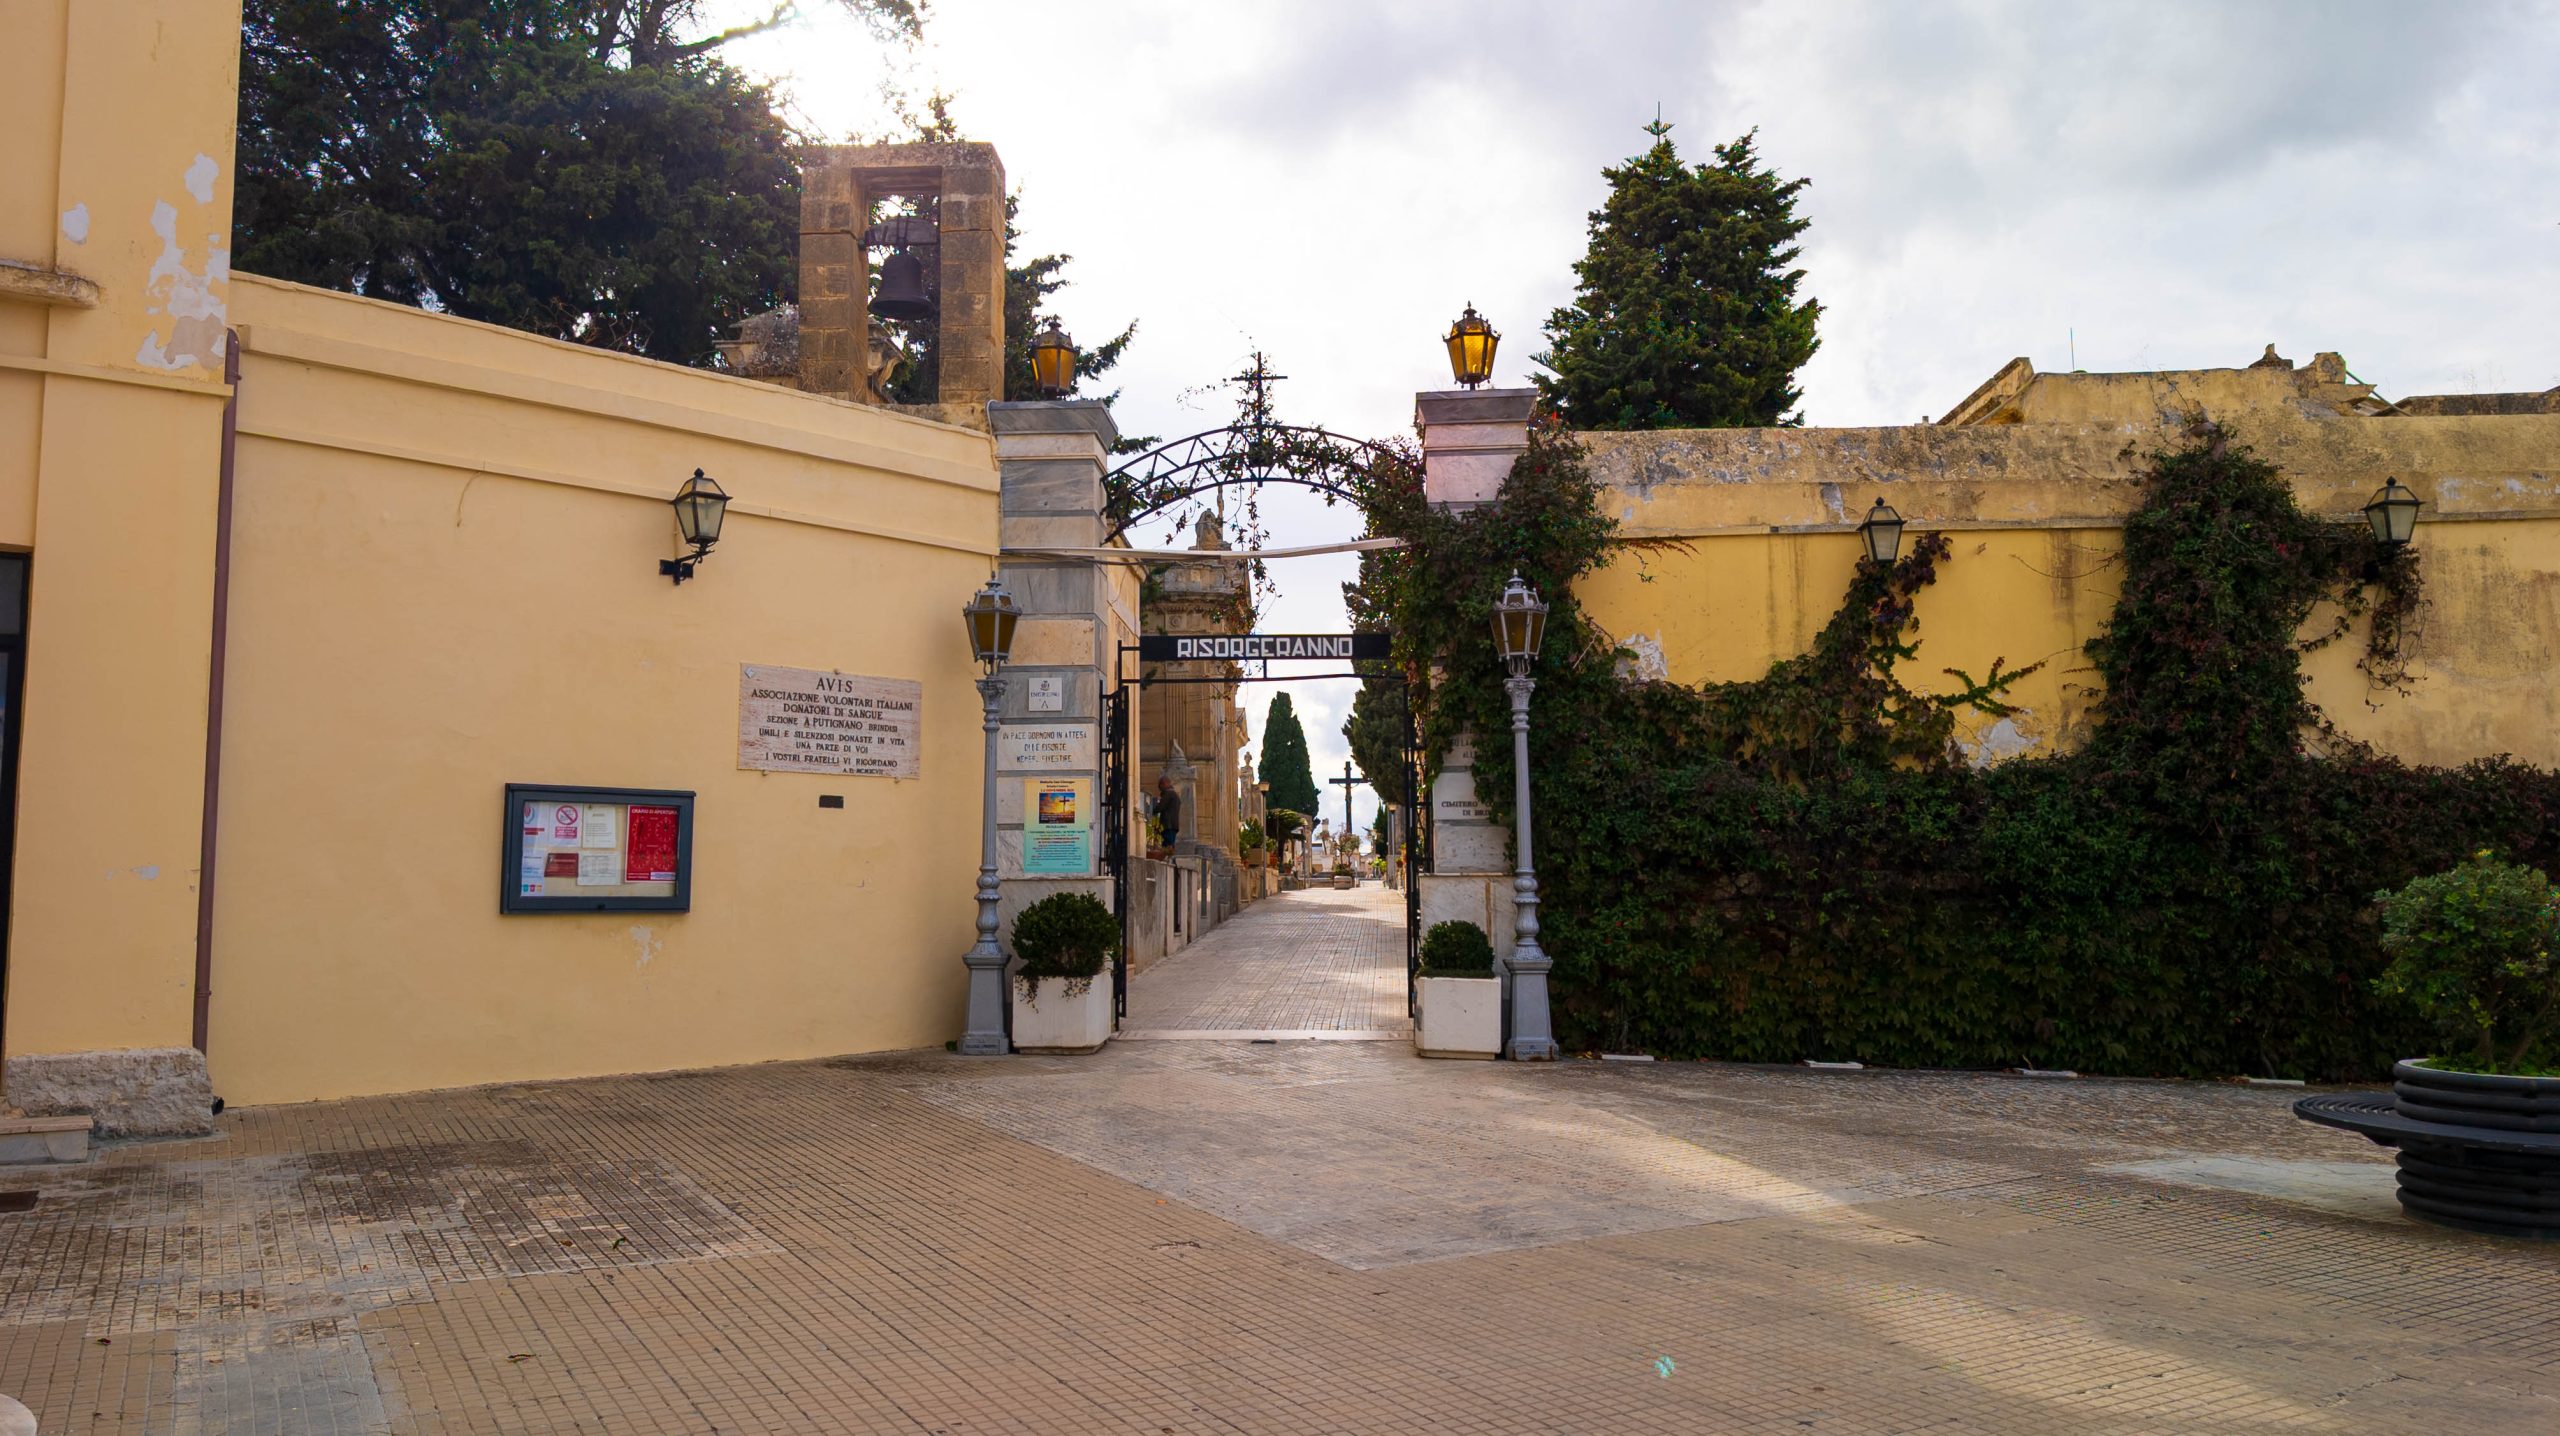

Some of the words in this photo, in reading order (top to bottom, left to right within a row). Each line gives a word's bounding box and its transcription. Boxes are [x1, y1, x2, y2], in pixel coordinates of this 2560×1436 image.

[1177, 637, 1353, 658] RISORGERANNO
[816, 677, 853, 694] AVIS
[751, 688, 820, 703] ASSOCIAZIONE
[823, 694, 873, 708] VOLONTARI
[877, 700, 913, 711] ITALIANI
[783, 703, 830, 715] DONATORI
[834, 707, 844, 717] DI
[848, 708, 883, 720] SANGUE
[766, 715, 798, 725] SEZIONE
[813, 717, 863, 730] PUTIGNANO
[868, 723, 898, 733] BRINDISI
[759, 728, 780, 737] UMILI
[784, 730, 790, 738] E
[794, 731, 834, 740] SILENZIOSI
[839, 734, 873, 744] DONASTE
[890, 737, 905, 746] VITA
[1056, 731, 1063, 739] IN
[1064, 730, 1087, 739] ATTESA
[795, 741, 811, 750] UNA
[816, 743, 839, 752] PARTE
[855, 745, 868, 754] VOI
[772, 752, 800, 762] VOSTRI
[804, 755, 839, 764] FRATELLI
[843, 757, 851, 765] VI
[855, 758, 897, 768] RICORDANO
[1462, 809, 1471, 817] DI
